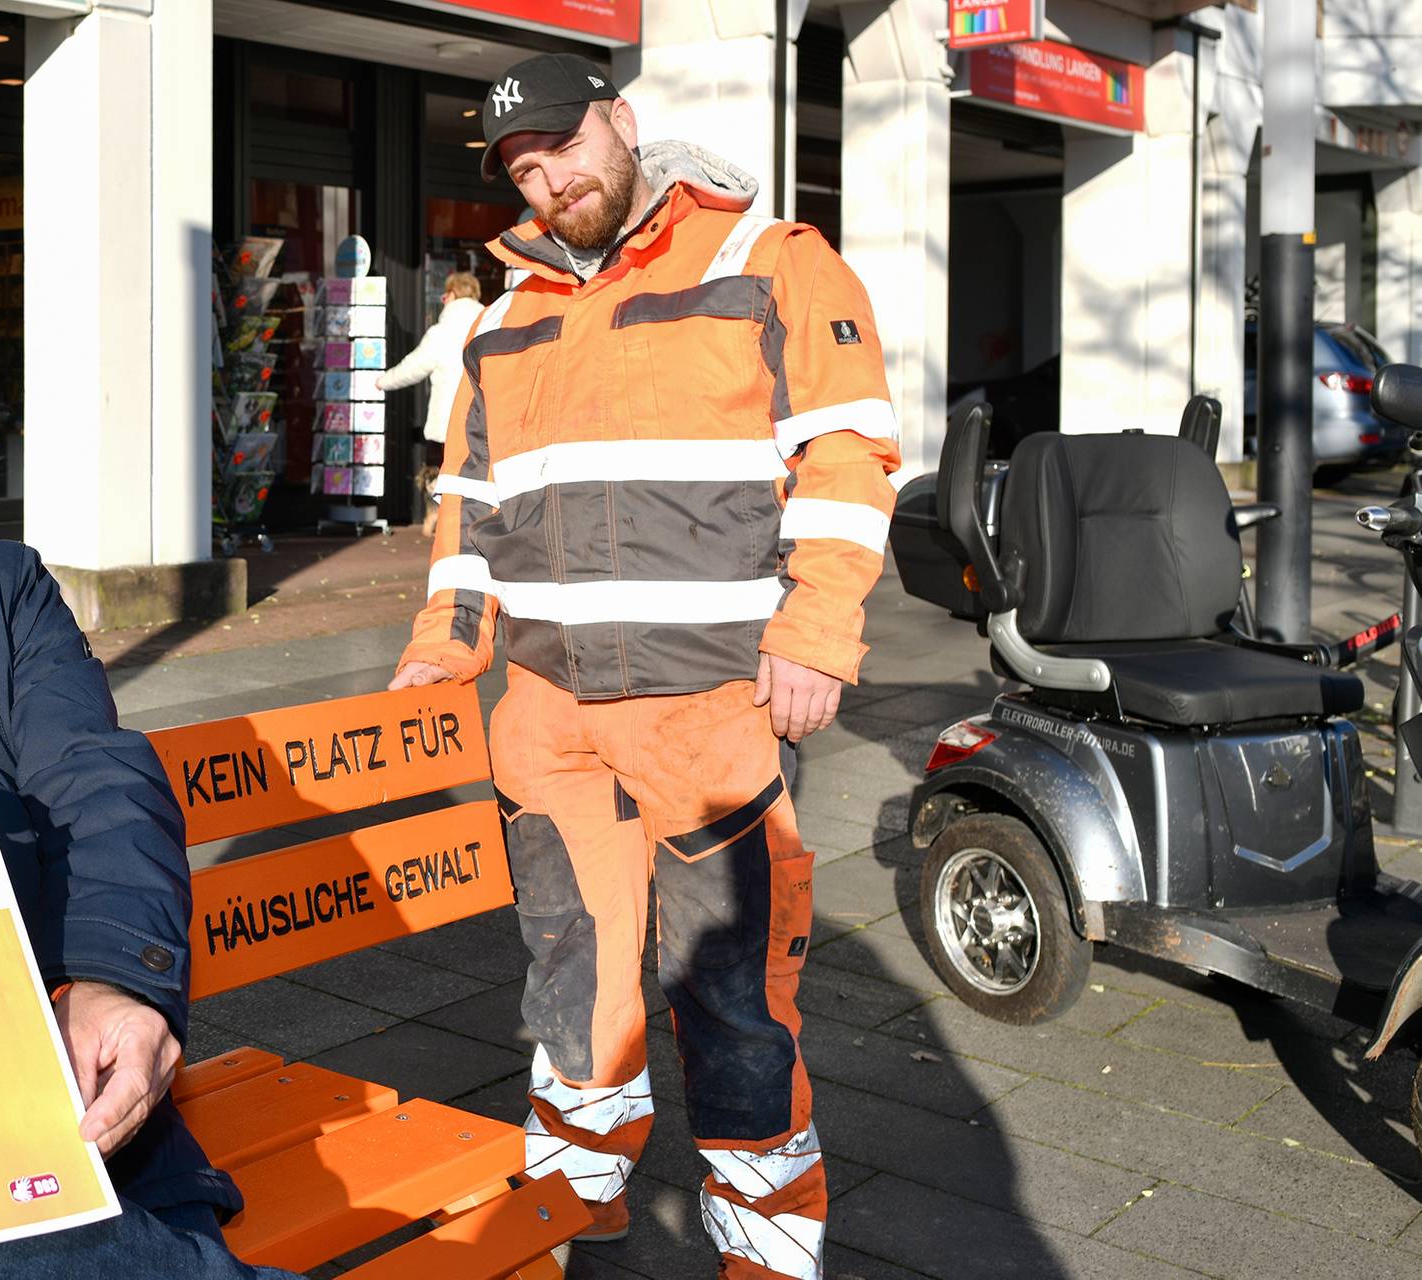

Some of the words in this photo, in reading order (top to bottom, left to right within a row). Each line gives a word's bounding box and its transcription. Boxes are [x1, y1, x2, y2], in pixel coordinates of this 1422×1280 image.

[183, 747, 268, 807] KEIN
[285, 725, 387, 785] PLATZ
[400, 707, 464, 763] FÜR
[1001, 708, 1135, 758] ELEKTROROLLER-FUTURA.DE
[205, 871, 375, 955] HÄUSLICHE
[385, 842, 482, 902] GEWALT
